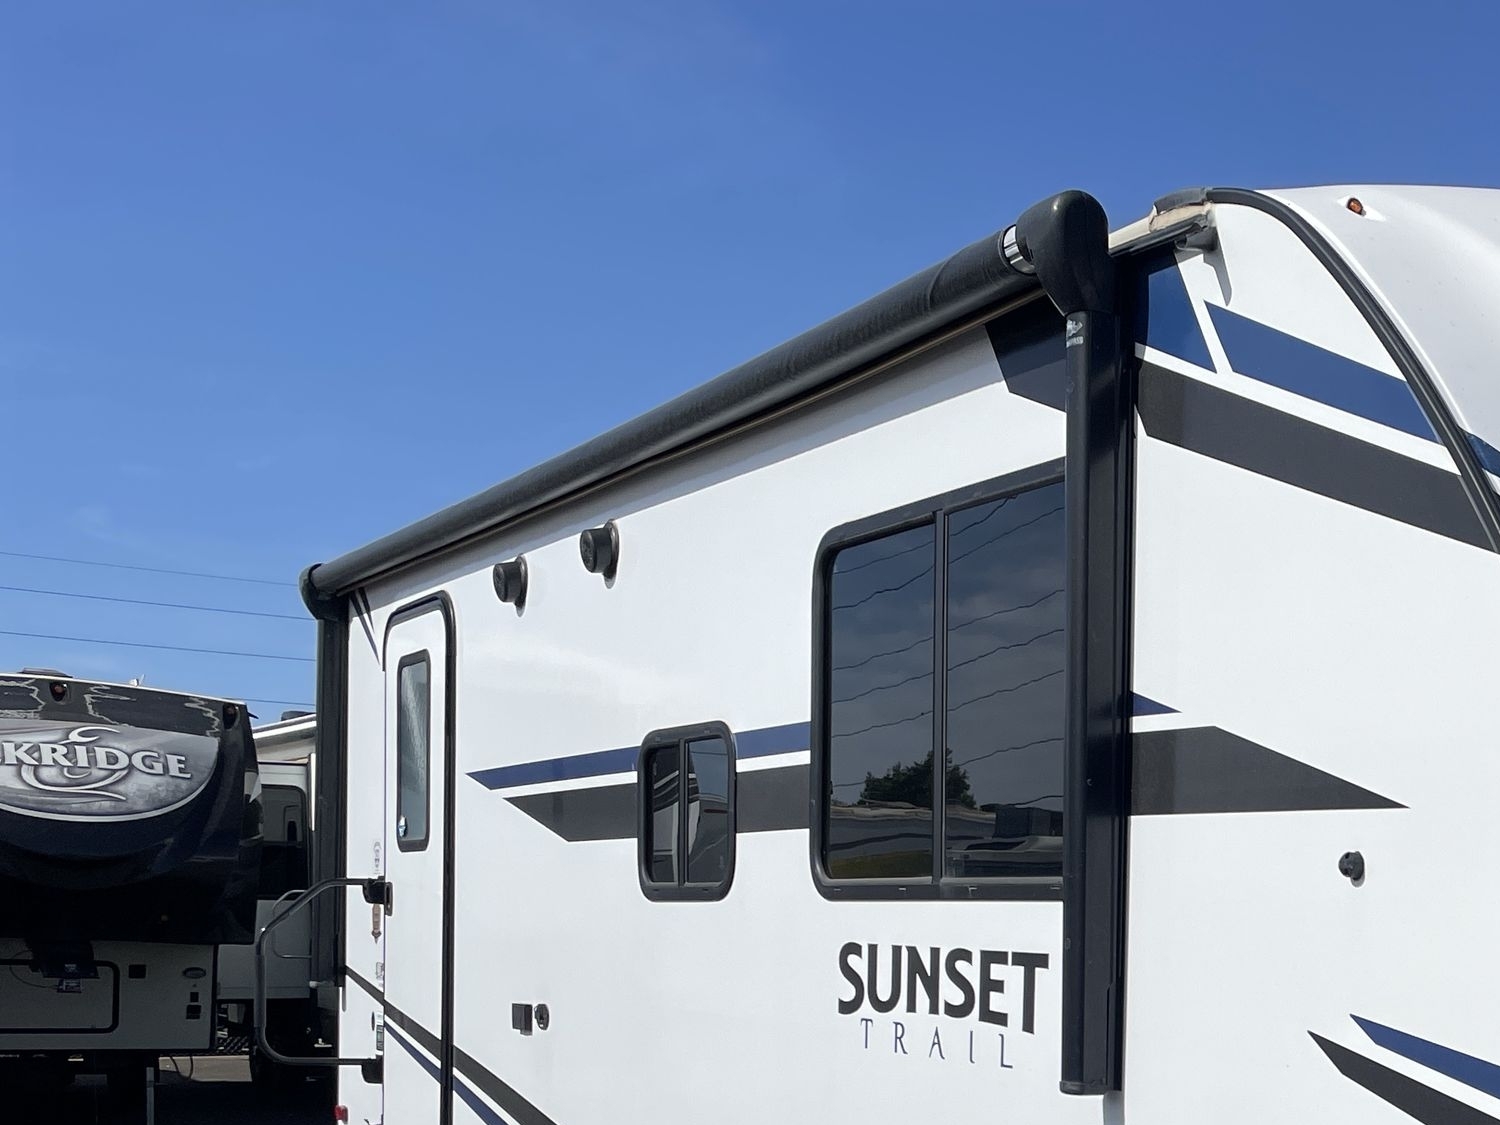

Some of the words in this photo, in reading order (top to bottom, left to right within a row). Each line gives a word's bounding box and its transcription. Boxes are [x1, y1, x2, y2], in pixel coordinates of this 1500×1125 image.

[0, 741, 192, 779] KRIDGE
[838, 941, 1050, 1035] SUNSET
[860, 1017, 1013, 1069] TRAIL
